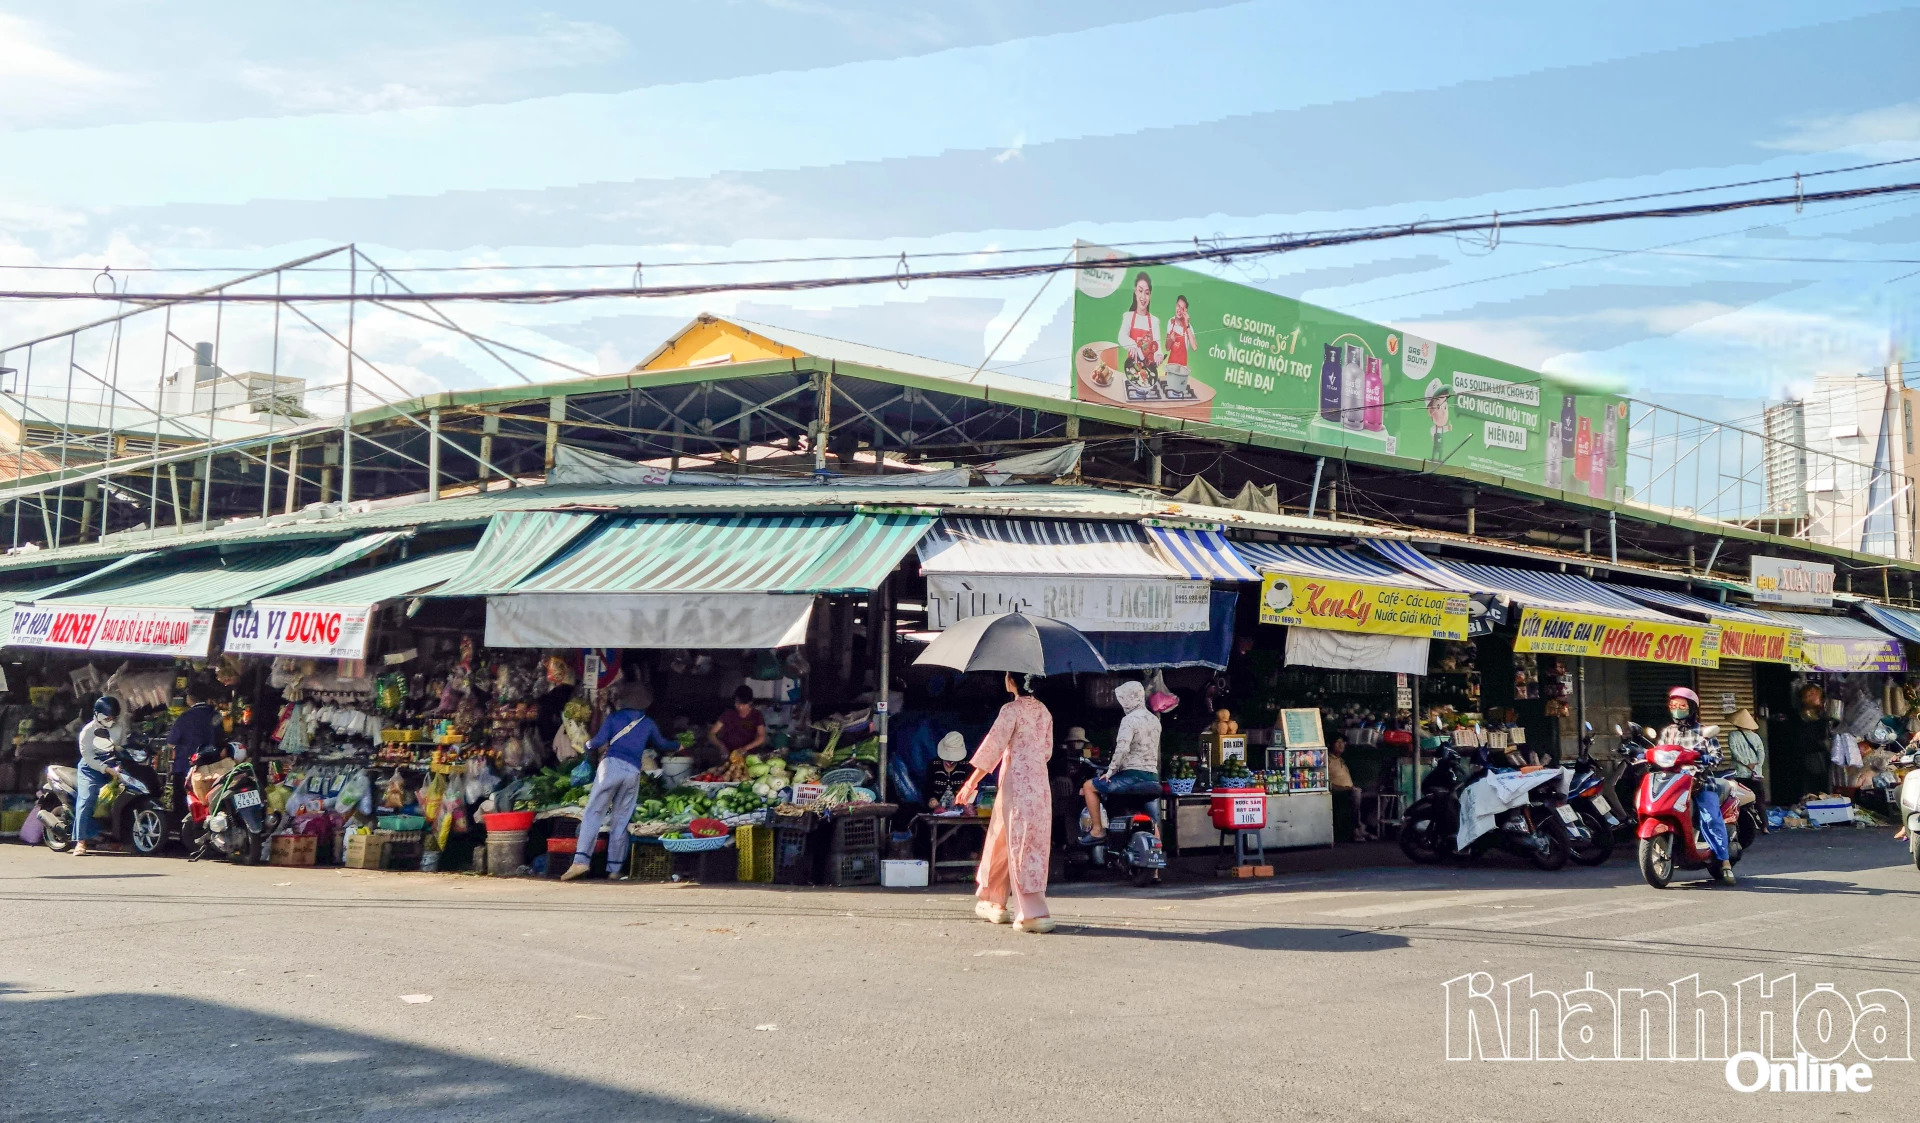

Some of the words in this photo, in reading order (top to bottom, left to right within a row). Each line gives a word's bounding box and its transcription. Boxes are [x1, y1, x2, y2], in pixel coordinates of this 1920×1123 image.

[1223, 313, 1242, 330] GAS
[1243, 318, 1276, 337] SOUTH
[1240, 333, 1252, 345] Lựa
[1253, 337, 1269, 349] chọn
[1270, 333, 1289, 355] Số
[1289, 327, 1300, 355] 1
[1408, 346, 1421, 355] GAS
[1209, 344, 1226, 360] cho
[1228, 345, 1266, 369] NGƯỜI
[1267, 355, 1288, 376] NỘI
[1290, 361, 1312, 382] TRỢ
[1407, 354, 1427, 366] SOUTH
[1224, 367, 1253, 389] HIỆN
[1254, 373, 1275, 394] ĐẠI
[1455, 376, 1468, 389] GAS
[1507, 386, 1524, 401] CHỌN
[1457, 394, 1475, 411] CHO
[1477, 399, 1504, 419] NGƯỜI
[1505, 406, 1520, 425] NỘI
[1521, 411, 1538, 431] TRỢ
[1488, 426, 1507, 445] HIỆN
[1508, 430, 1523, 448] ĐẠI
[1378, 591, 1399, 607] Café
[1406, 594, 1422, 608] Các
[1425, 597, 1445, 612] Loại
[11, 611, 31, 640] TẠP
[27, 608, 54, 635] HÓA
[45, 612, 97, 645] MINH
[232, 609, 259, 639] GIA
[267, 610, 286, 648] VỊ
[285, 611, 341, 645] DUNG
[1374, 608, 1397, 622] Nước
[1400, 610, 1417, 624] Giải
[1420, 613, 1442, 626] Khát
[1521, 612, 1542, 637] CỬA
[1541, 616, 1574, 639] HÀNG
[1573, 622, 1593, 641] GIA
[1593, 624, 1606, 646] VỊ
[101, 619, 119, 642] BAO
[152, 616, 170, 646] CÁC
[170, 621, 189, 652] LOẠI
[1600, 621, 1654, 659] HỒNG
[1654, 633, 1694, 663] SƠN
[1242, 814, 1256, 823] 10K
